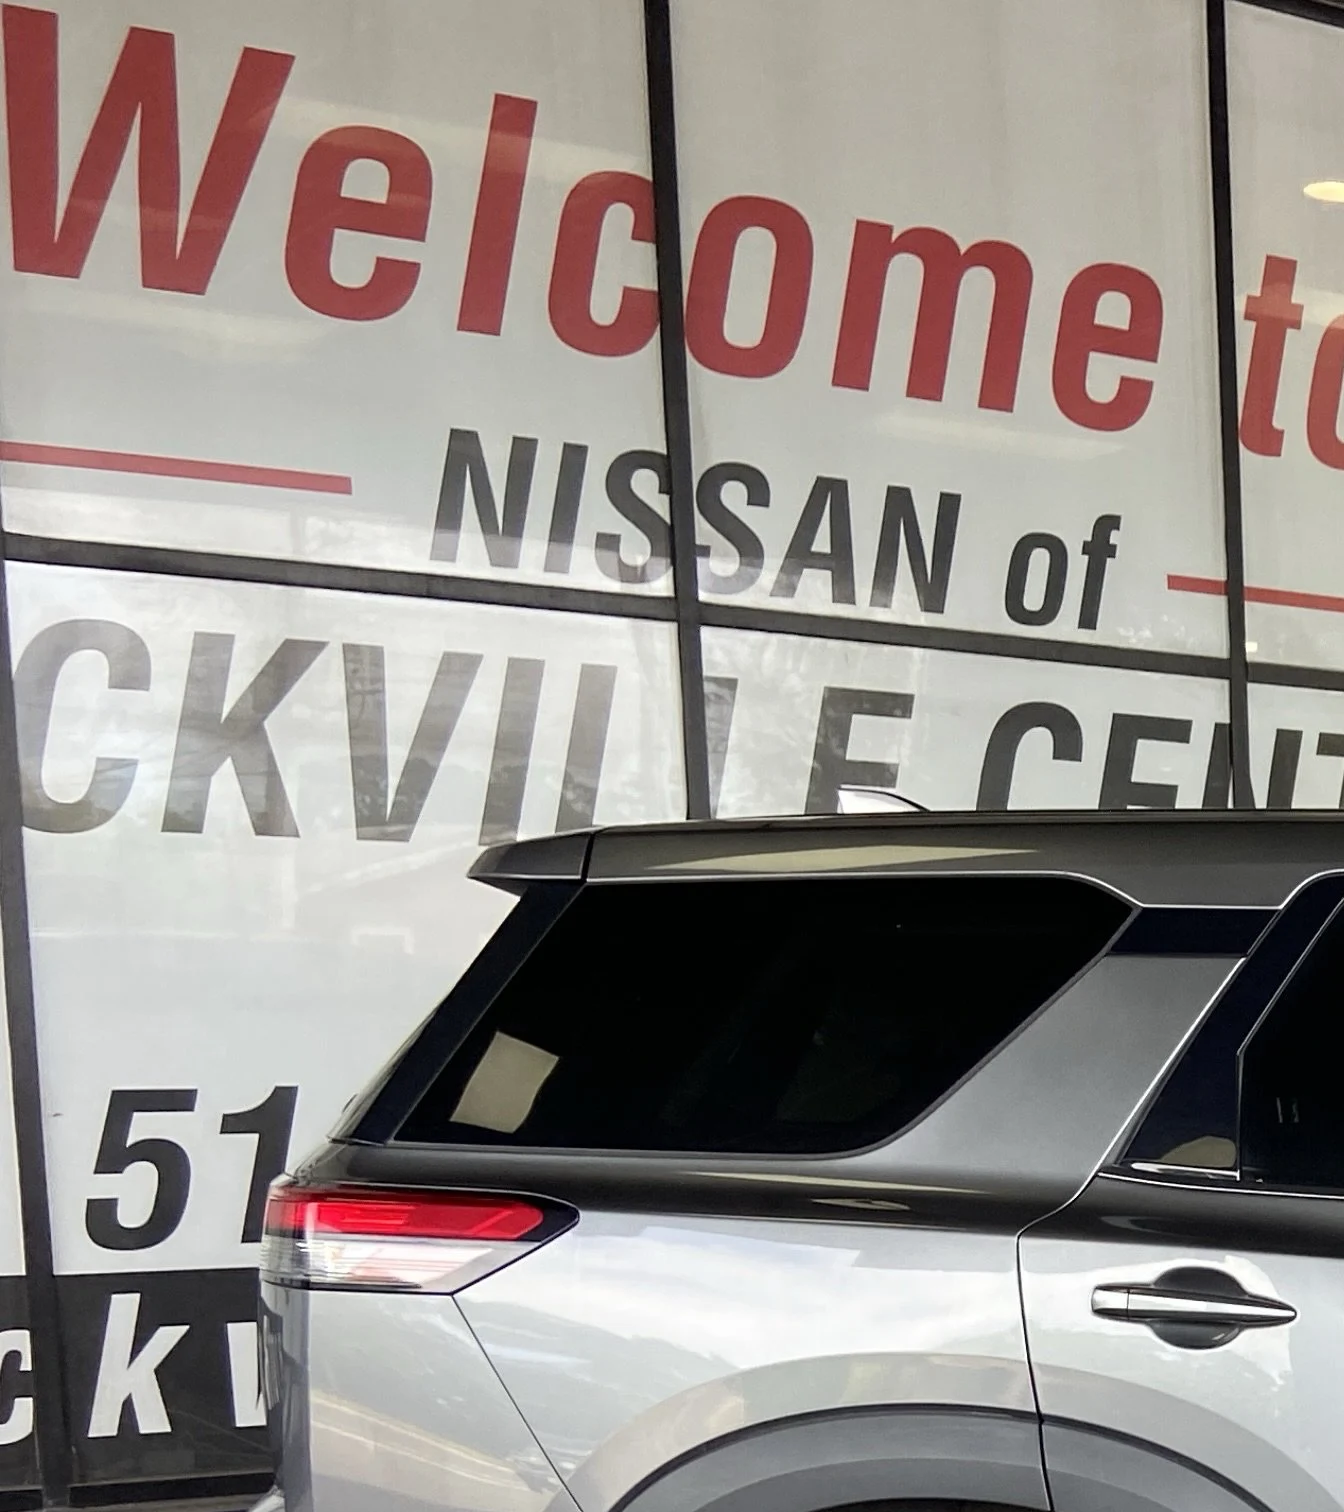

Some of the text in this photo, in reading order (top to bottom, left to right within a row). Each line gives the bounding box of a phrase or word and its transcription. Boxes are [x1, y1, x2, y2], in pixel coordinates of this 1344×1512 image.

[0, 3, 1163, 431] Welcome
[429, 427, 1121, 630] NISSAN of
[85, 1086, 298, 1251] 51
